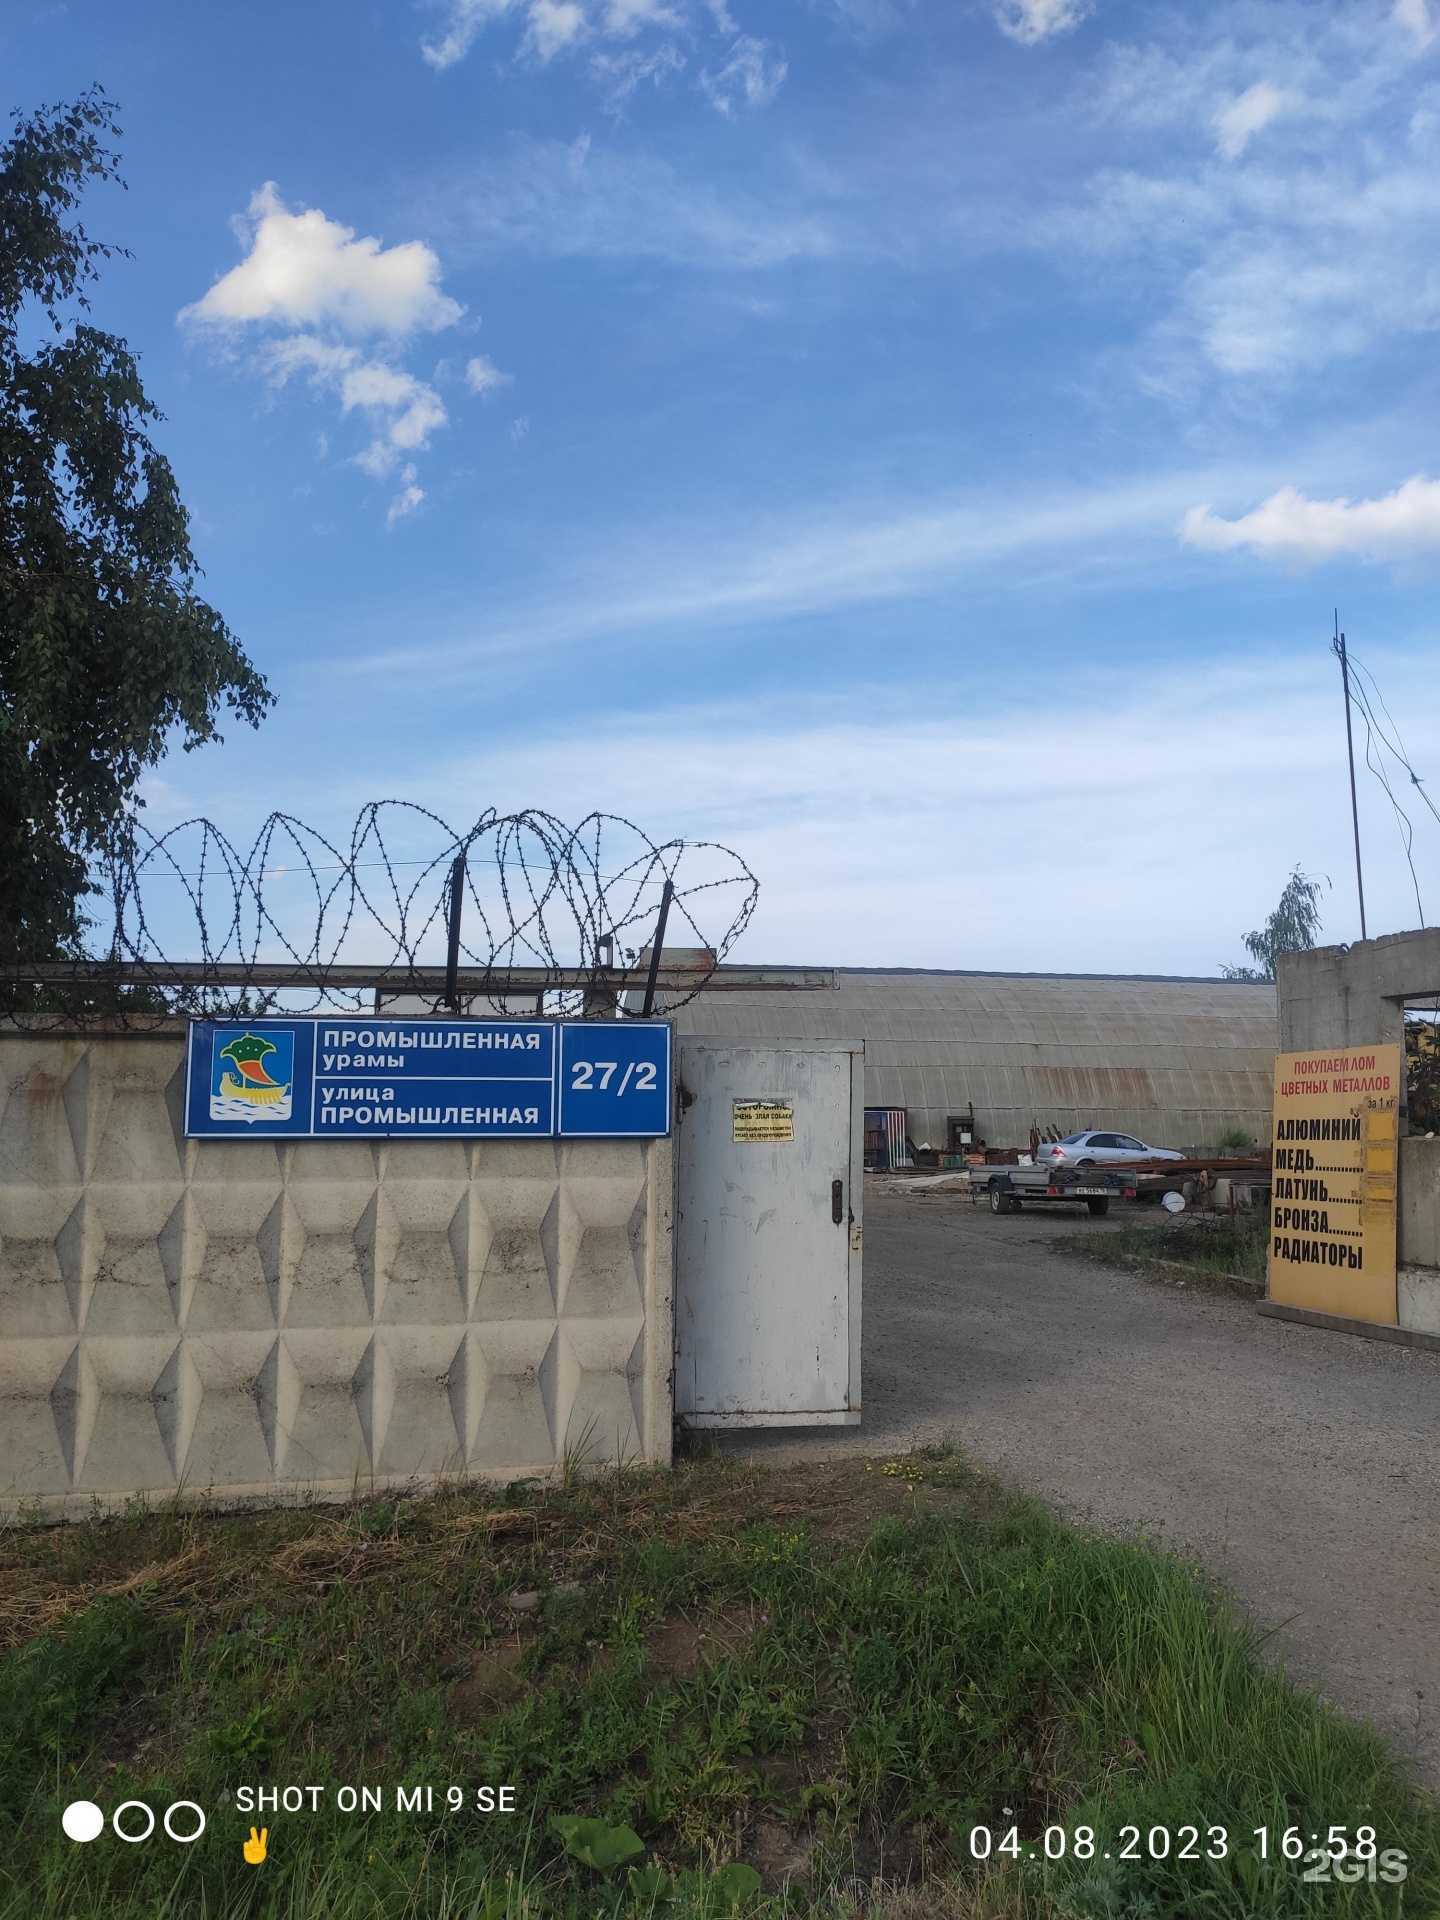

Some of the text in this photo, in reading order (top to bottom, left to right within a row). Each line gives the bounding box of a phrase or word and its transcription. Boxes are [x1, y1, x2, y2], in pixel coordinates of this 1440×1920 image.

[323, 1030, 541, 1051] ПРОМЫШЛЕННАЯ
[322, 1054, 406, 1071] урамы
[1294, 1055, 1376, 1075] ПОКУПАЕМ ЛОМ
[570, 1061, 657, 1097] 27/2
[1281, 1076, 1391, 1097] ЦВЕТНЫХ МЕТАЛЛОВ
[321, 1086, 396, 1103] улица
[320, 1106, 539, 1126] ПРОМЫШЛЕННАЯ
[1277, 1111, 1361, 1141] АЛЮМИНИЙ
[1273, 1236, 1363, 1269] РАДИАТОРЫ
